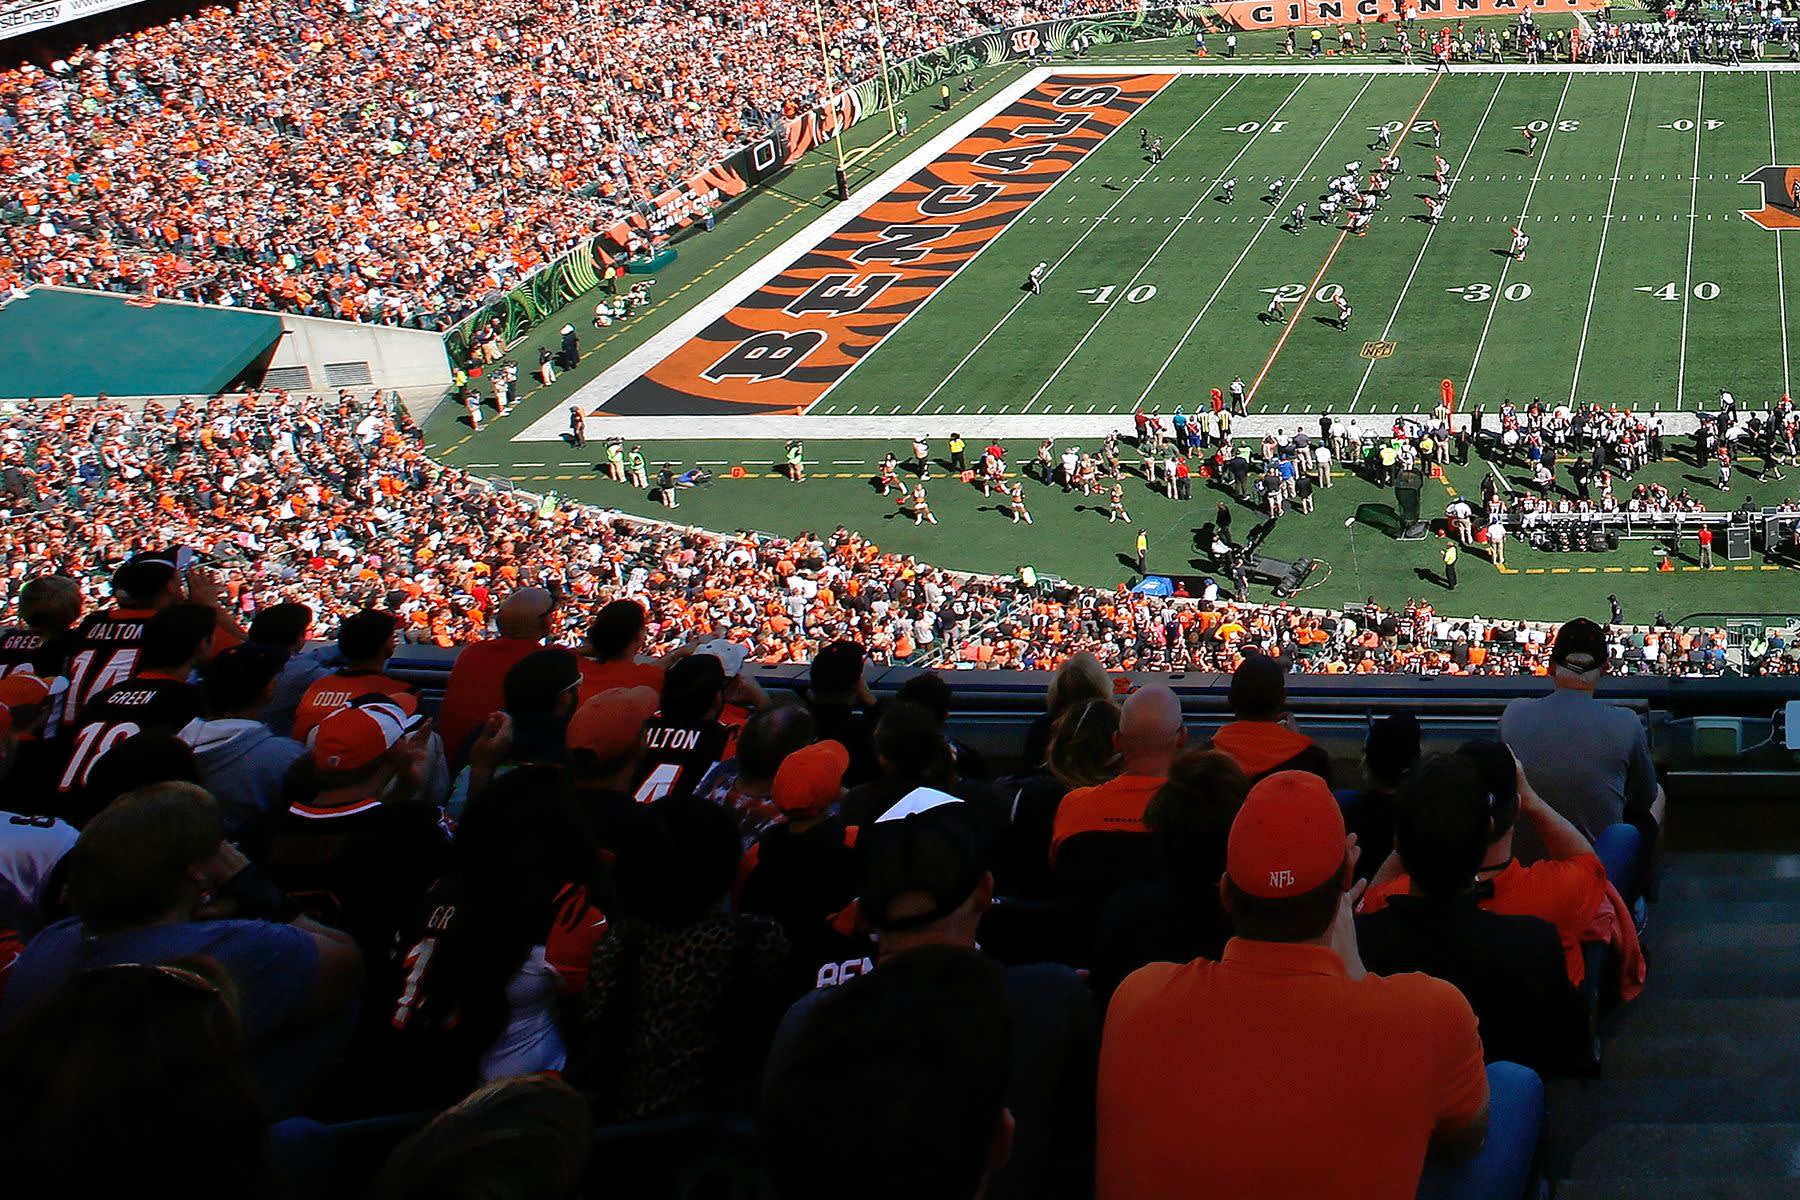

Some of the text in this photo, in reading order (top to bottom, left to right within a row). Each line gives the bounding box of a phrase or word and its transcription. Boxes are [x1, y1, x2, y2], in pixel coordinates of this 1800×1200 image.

[0, 4, 62, 30] stEnergy
[698, 84, 1123, 385] BENGALS
[1087, 283, 1158, 304] 10
[1277, 283, 1345, 303] 20
[1462, 282, 1533, 302] 30
[1652, 281, 1721, 301] 40
[64, 649, 140, 722] 14
[107, 689, 159, 706] GREEN
[1268, 869, 1296, 888] NFL
